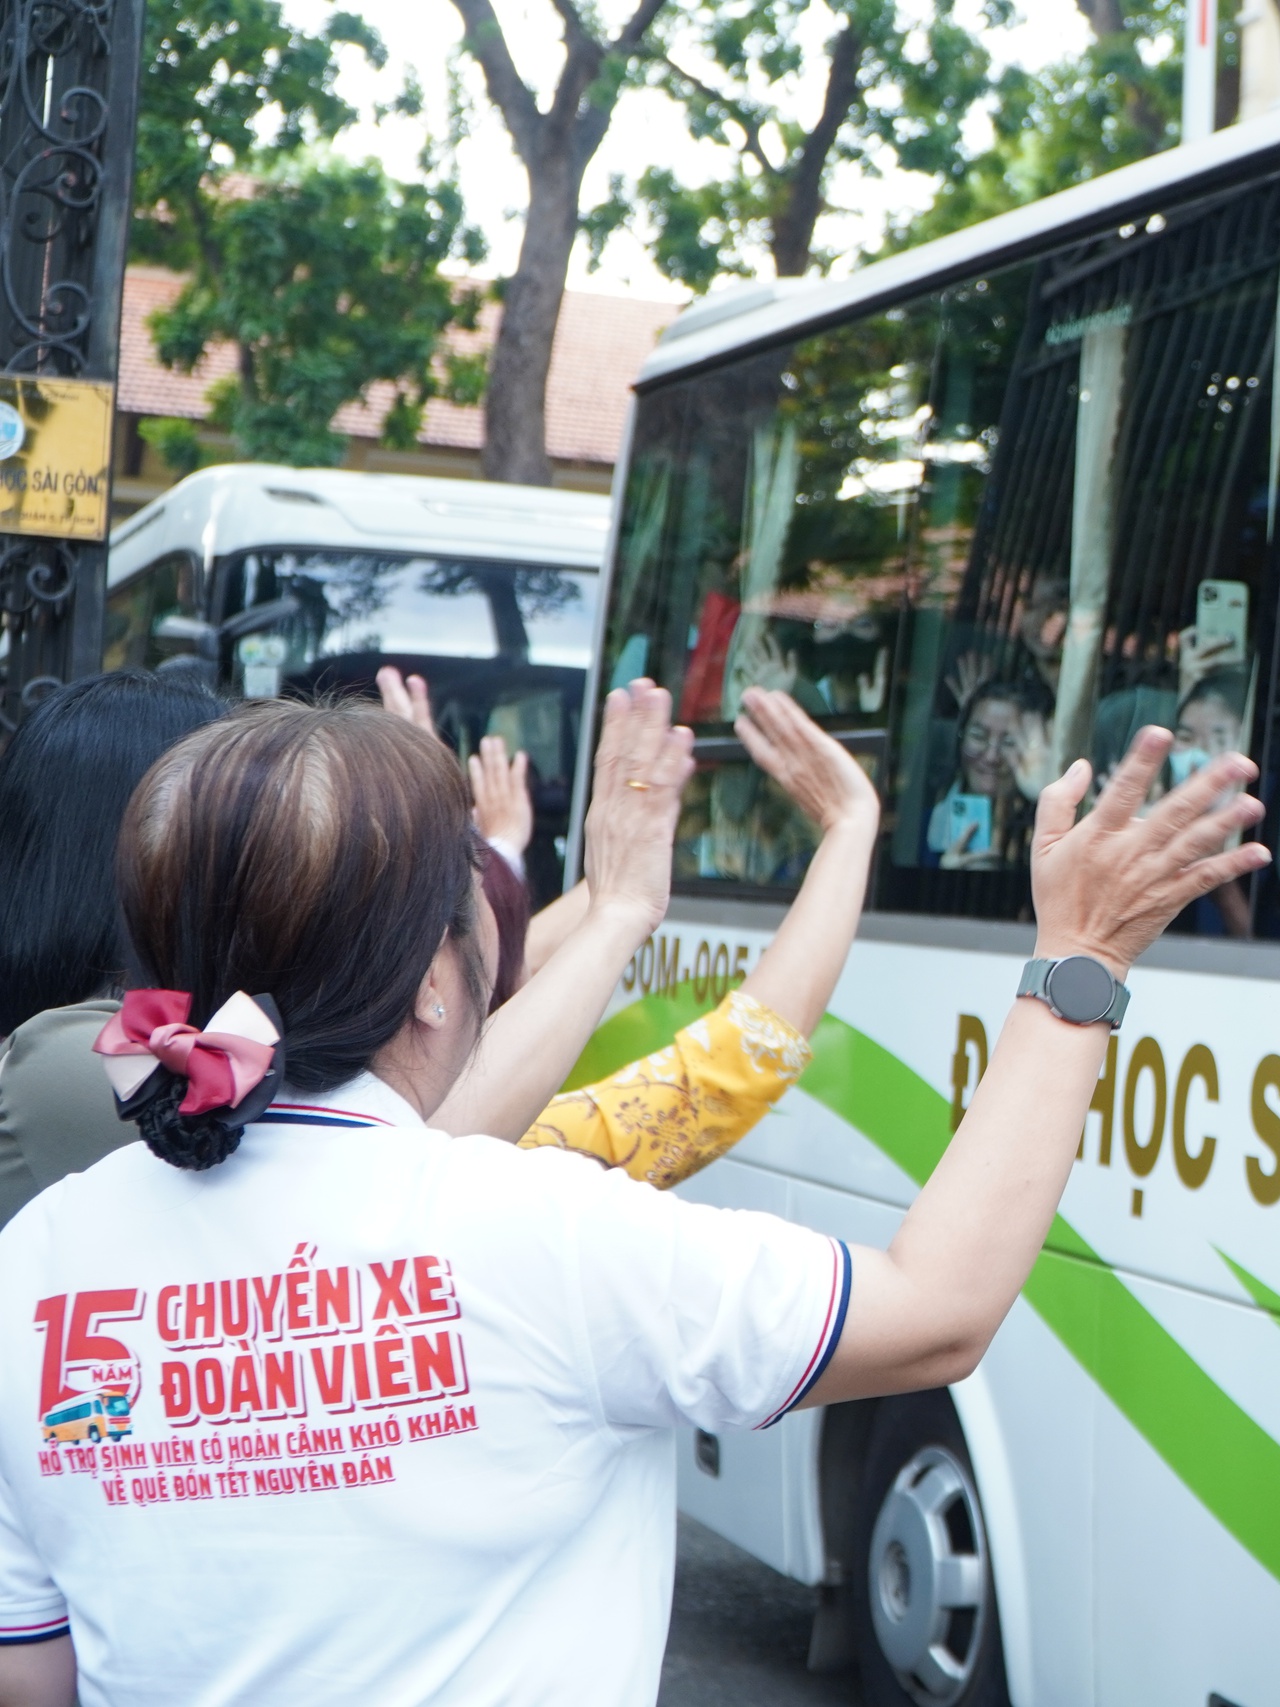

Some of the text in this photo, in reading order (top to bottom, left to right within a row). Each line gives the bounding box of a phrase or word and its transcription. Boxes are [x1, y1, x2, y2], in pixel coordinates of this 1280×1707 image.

[32, 465, 58, 493] SÀI
[63, 469, 98, 496] GÒN
[1074, 1033, 1219, 1219] HỌC
[157, 1242, 462, 1351] CHUYẾN XE
[33, 1288, 146, 1423] 15
[91, 1363, 133, 1383] NĂM
[160, 1324, 469, 1428] ĐOÀN VIÊN
[64, 1446, 99, 1479] TRỢ
[101, 1443, 149, 1471] SINH
[150, 1435, 197, 1467] VIÊN
[200, 1431, 227, 1464] CÓ
[227, 1428, 282, 1461] HOÀN
[286, 1423, 346, 1458] CẢNH
[349, 1413, 402, 1451] KHÓ
[407, 1404, 479, 1442] KHĂN
[102, 1453, 396, 1507] VỀ QUÊ ĐÓN TẾT NGUYÊN ĐÁN
